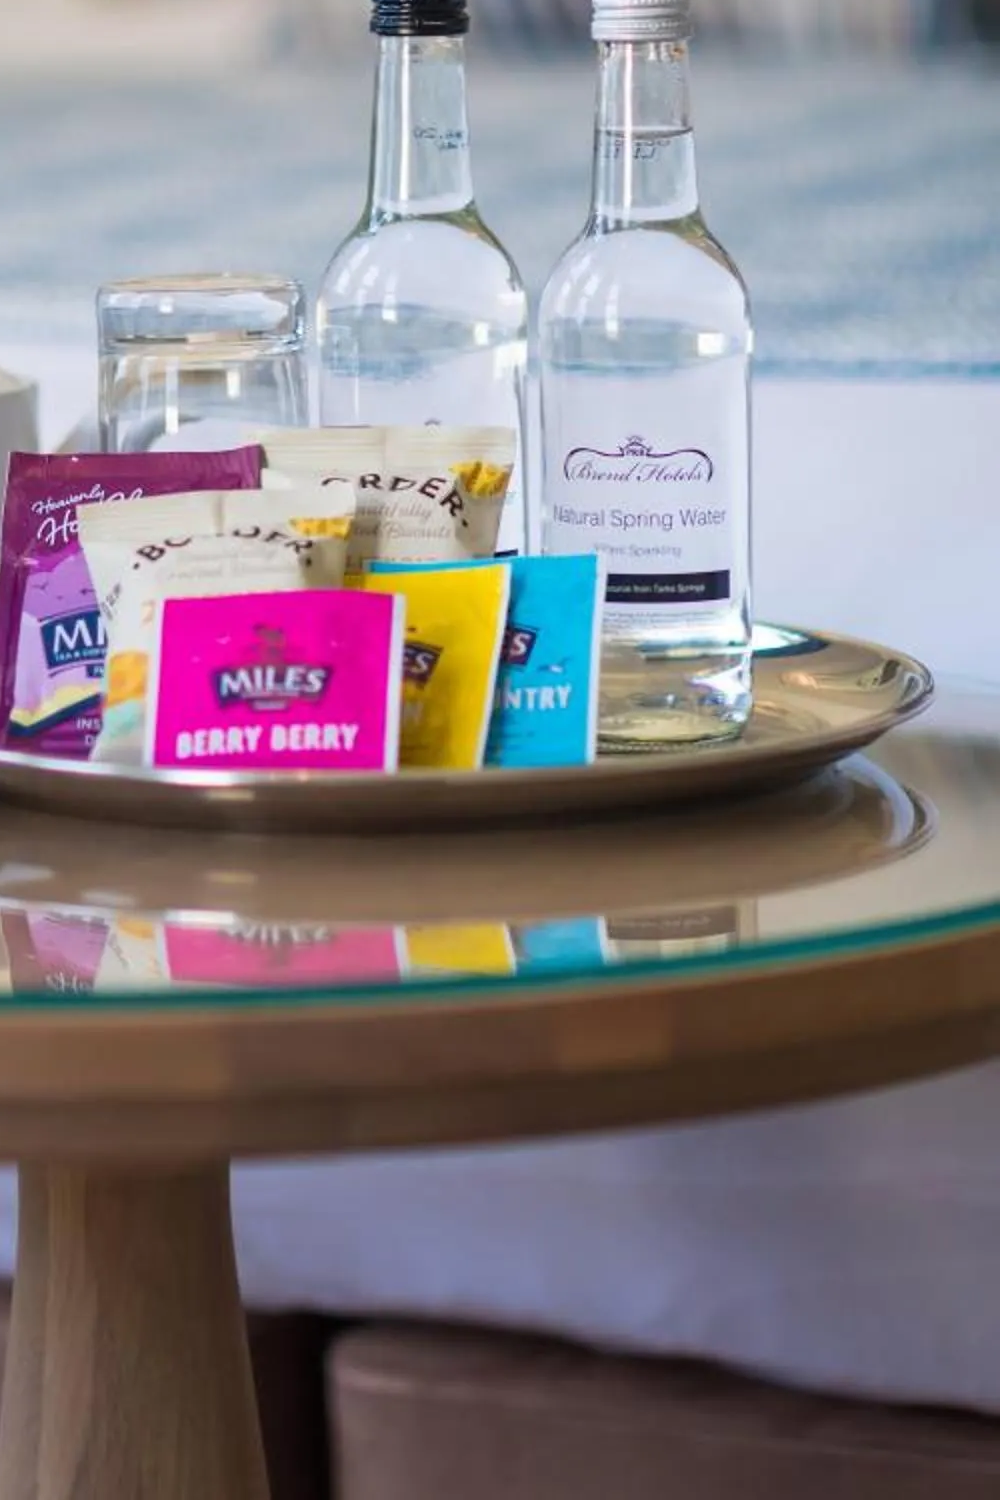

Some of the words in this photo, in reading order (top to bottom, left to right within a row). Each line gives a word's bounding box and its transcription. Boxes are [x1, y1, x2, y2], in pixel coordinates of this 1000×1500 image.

[31, 483, 105, 515] Heavenly
[553, 505, 606, 527] Natural
[610, 509, 674, 531] Spring
[679, 509, 728, 527] Water
[219, 664, 328, 697] MILES
[504, 682, 572, 711] NTRY
[175, 724, 264, 760] BERRY
[269, 723, 361, 753] BERRY
